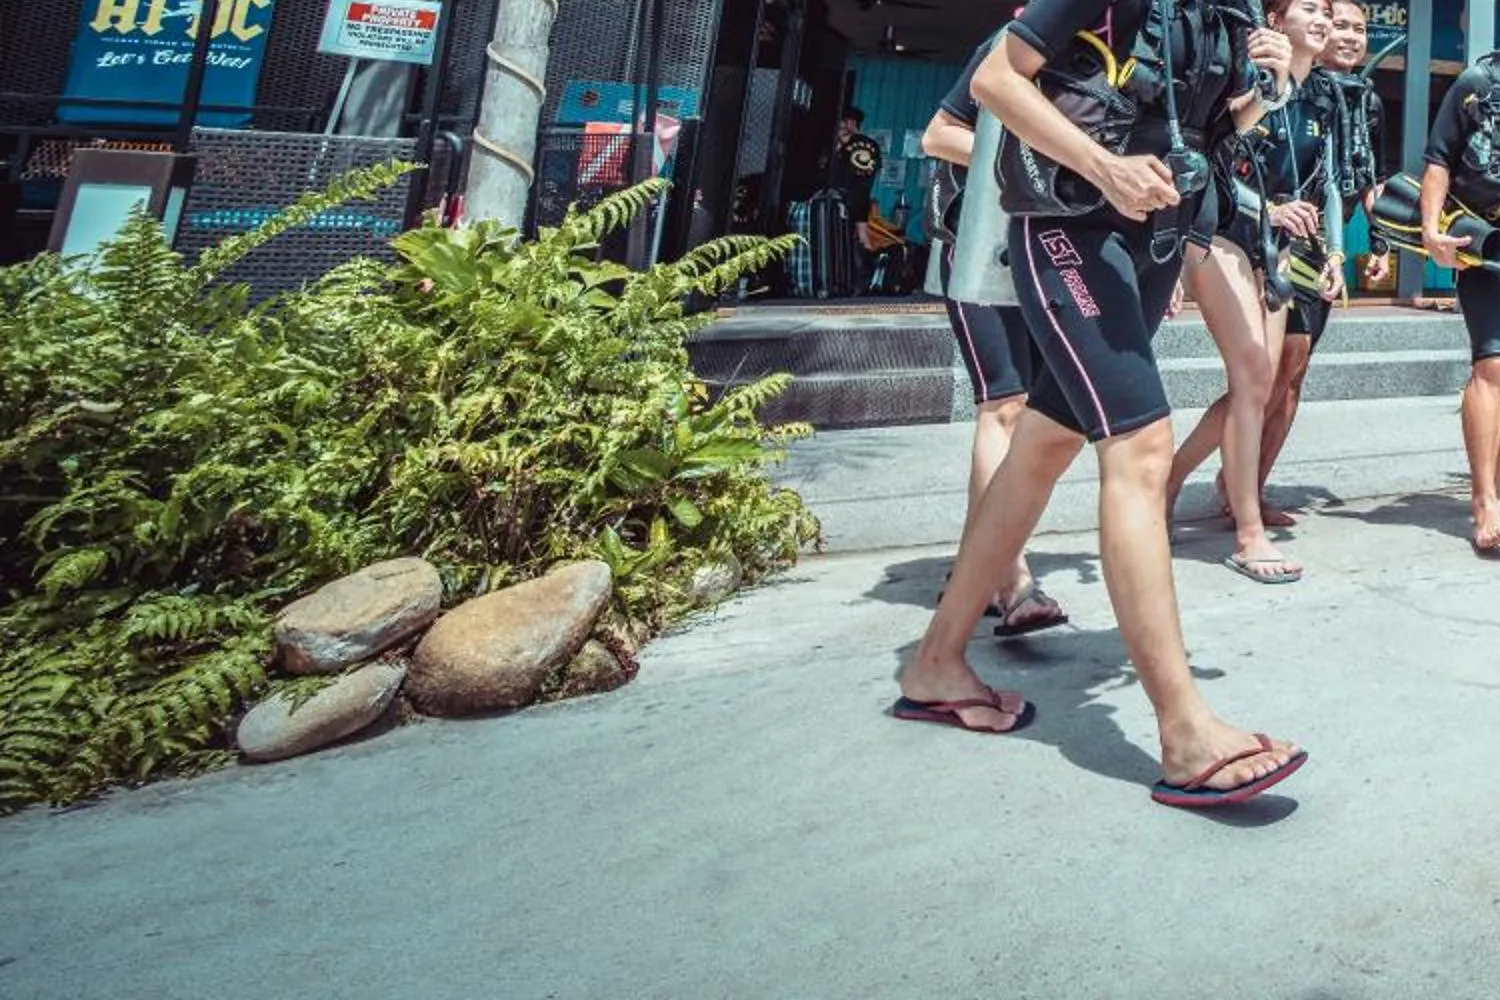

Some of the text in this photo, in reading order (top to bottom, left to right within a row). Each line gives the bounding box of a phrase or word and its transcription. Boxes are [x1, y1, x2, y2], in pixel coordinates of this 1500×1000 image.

[371, 4, 416, 18] PRIVATE
[361, 13, 423, 29] PROPERTY
[347, 23, 431, 38] NO TRESPASSING
[96, 50, 146, 68] Let's
[152, 49, 193, 66] Get
[1037, 228, 1083, 266] IST
